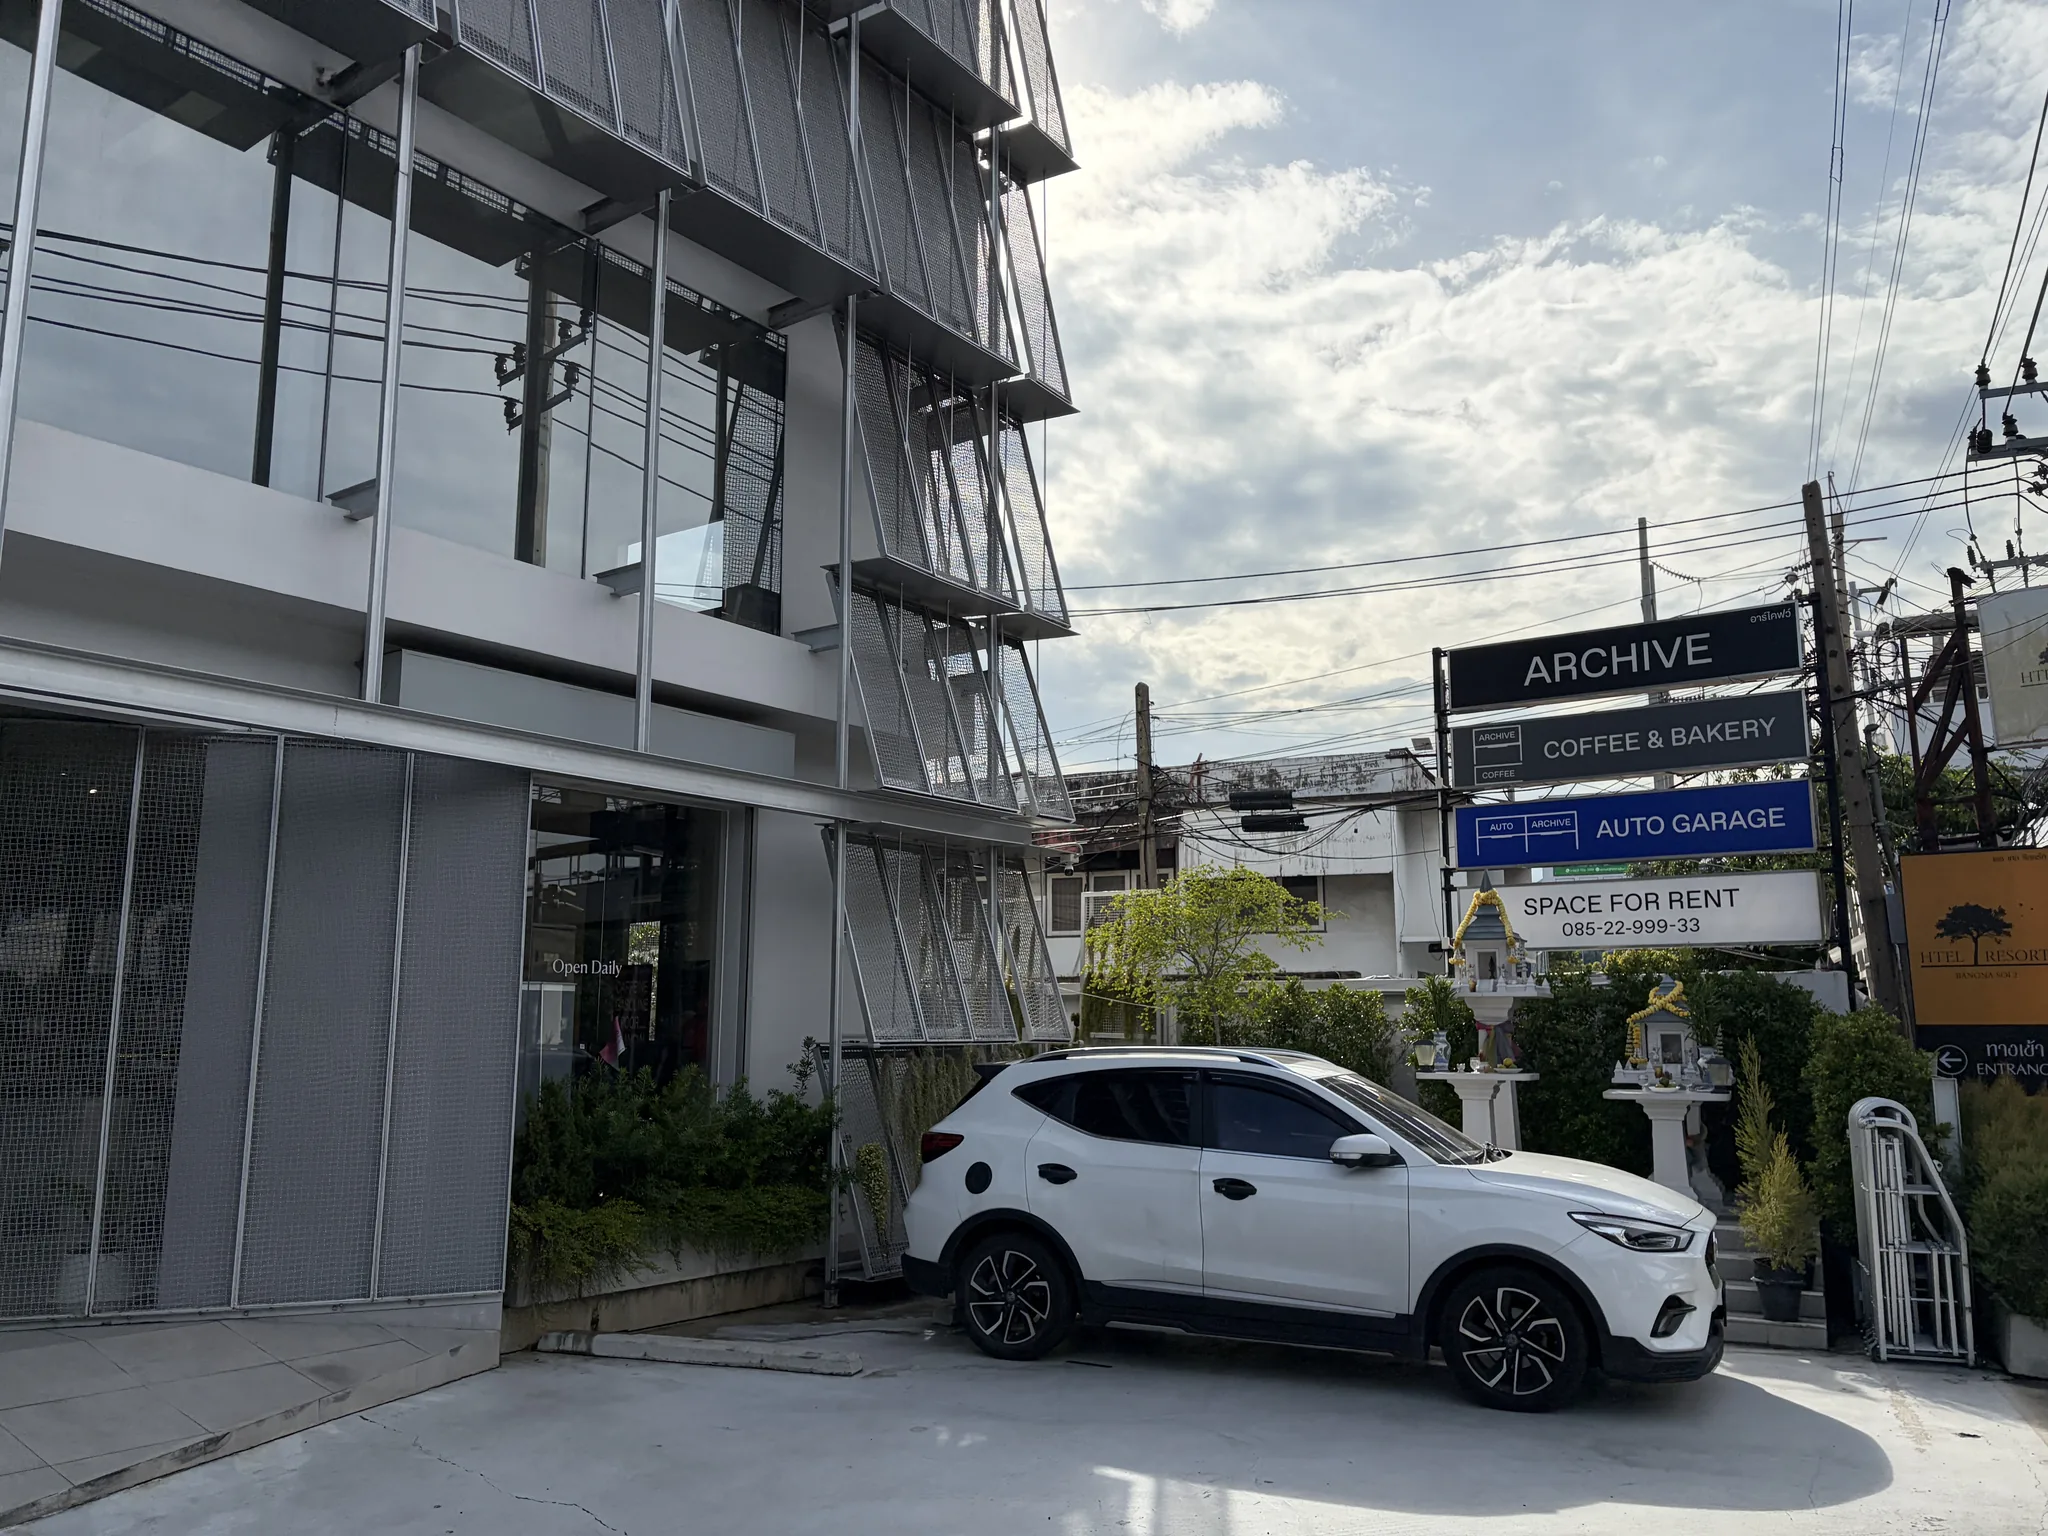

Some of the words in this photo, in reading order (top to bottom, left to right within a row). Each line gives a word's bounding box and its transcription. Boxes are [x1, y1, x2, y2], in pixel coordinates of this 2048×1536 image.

[1523, 632, 1713, 687] ARCHIVE
[1478, 730, 1516, 742] ARCHIVE
[1543, 731, 1640, 760] COFFEE
[1647, 730, 1664, 749] &
[1671, 716, 1777, 747] BAKERY
[1481, 769, 1516, 780] COFFEE
[1489, 821, 1514, 832] AUTO
[1531, 817, 1572, 828] ARCHIVE
[1596, 814, 1665, 839] AUTO
[1672, 807, 1786, 833] GARAGE
[1523, 894, 1602, 917] SPACE
[1610, 891, 1661, 912] FOR
[1668, 887, 1740, 909] RENT
[1562, 917, 1700, 937] 085-22-999-33
[1920, 950, 1964, 963] HTEL
[1985, 948, 2048, 963] RESORT
[552, 958, 588, 979] Open
[591, 960, 622, 979] Daily
[1986, 1039, 2045, 1057] ทางเข้า
